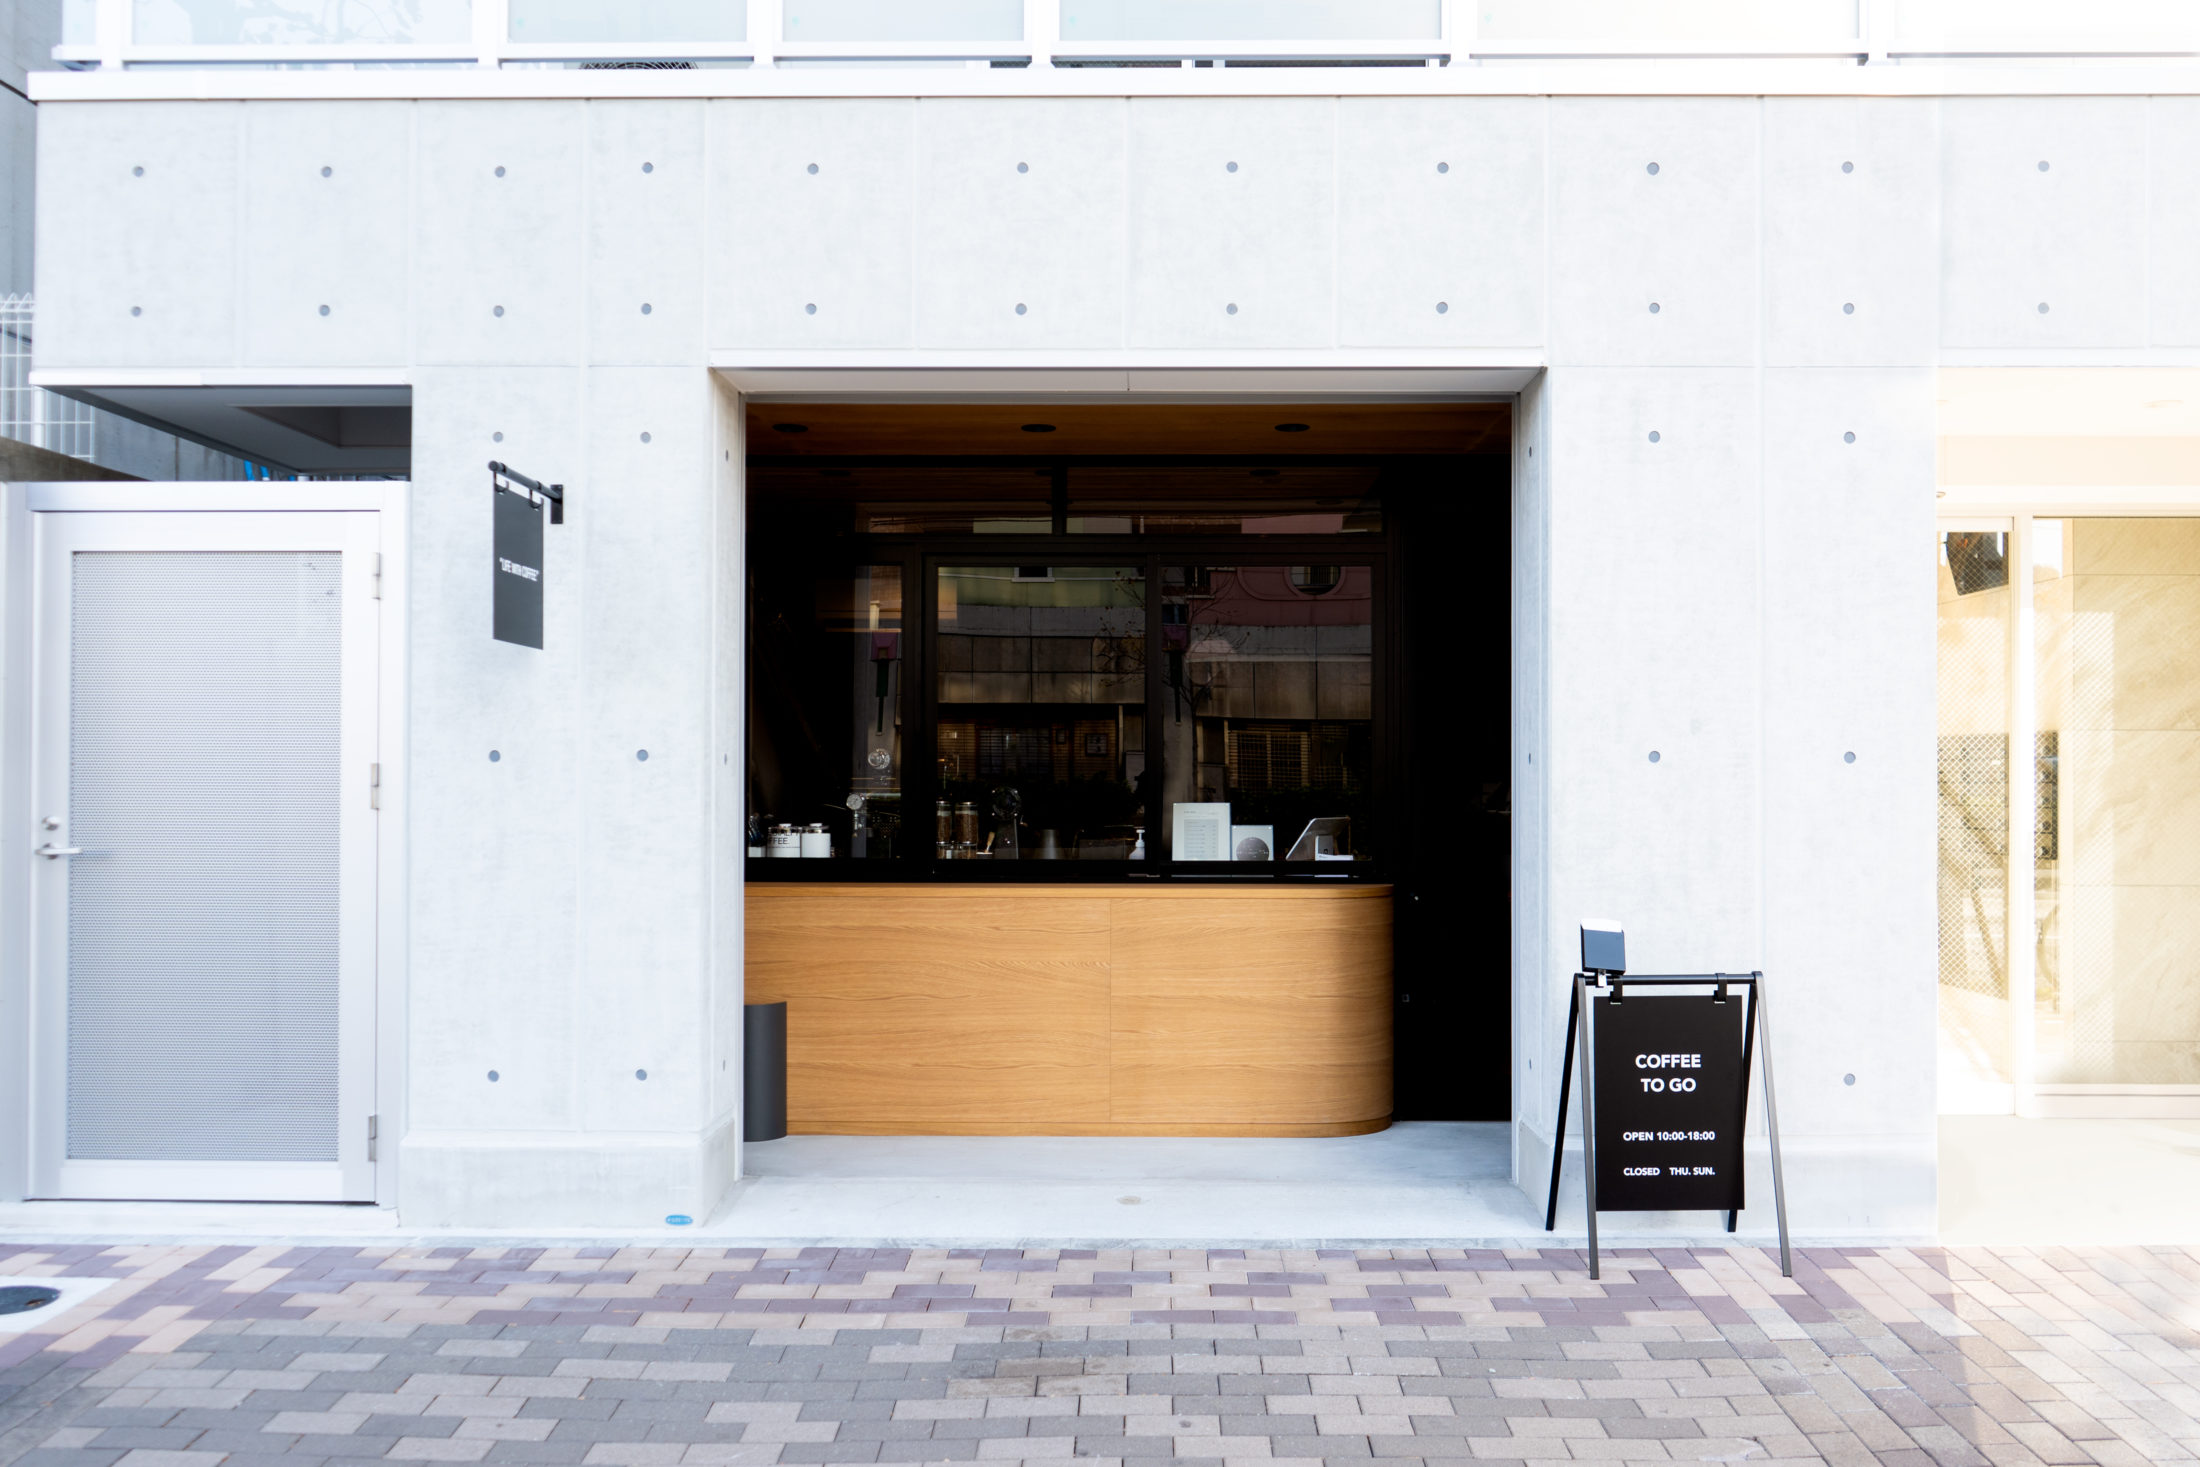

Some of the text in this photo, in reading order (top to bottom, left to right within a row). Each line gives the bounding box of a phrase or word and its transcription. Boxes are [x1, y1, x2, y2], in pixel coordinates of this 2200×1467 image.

[1634, 1053, 1702, 1069] COFFEE
[1640, 1077, 1697, 1093] TO GO
[1622, 1130, 1716, 1142] OPEN 10:00-18:00
[1623, 1166, 1716, 1177] CLOSED THU. SUN.
